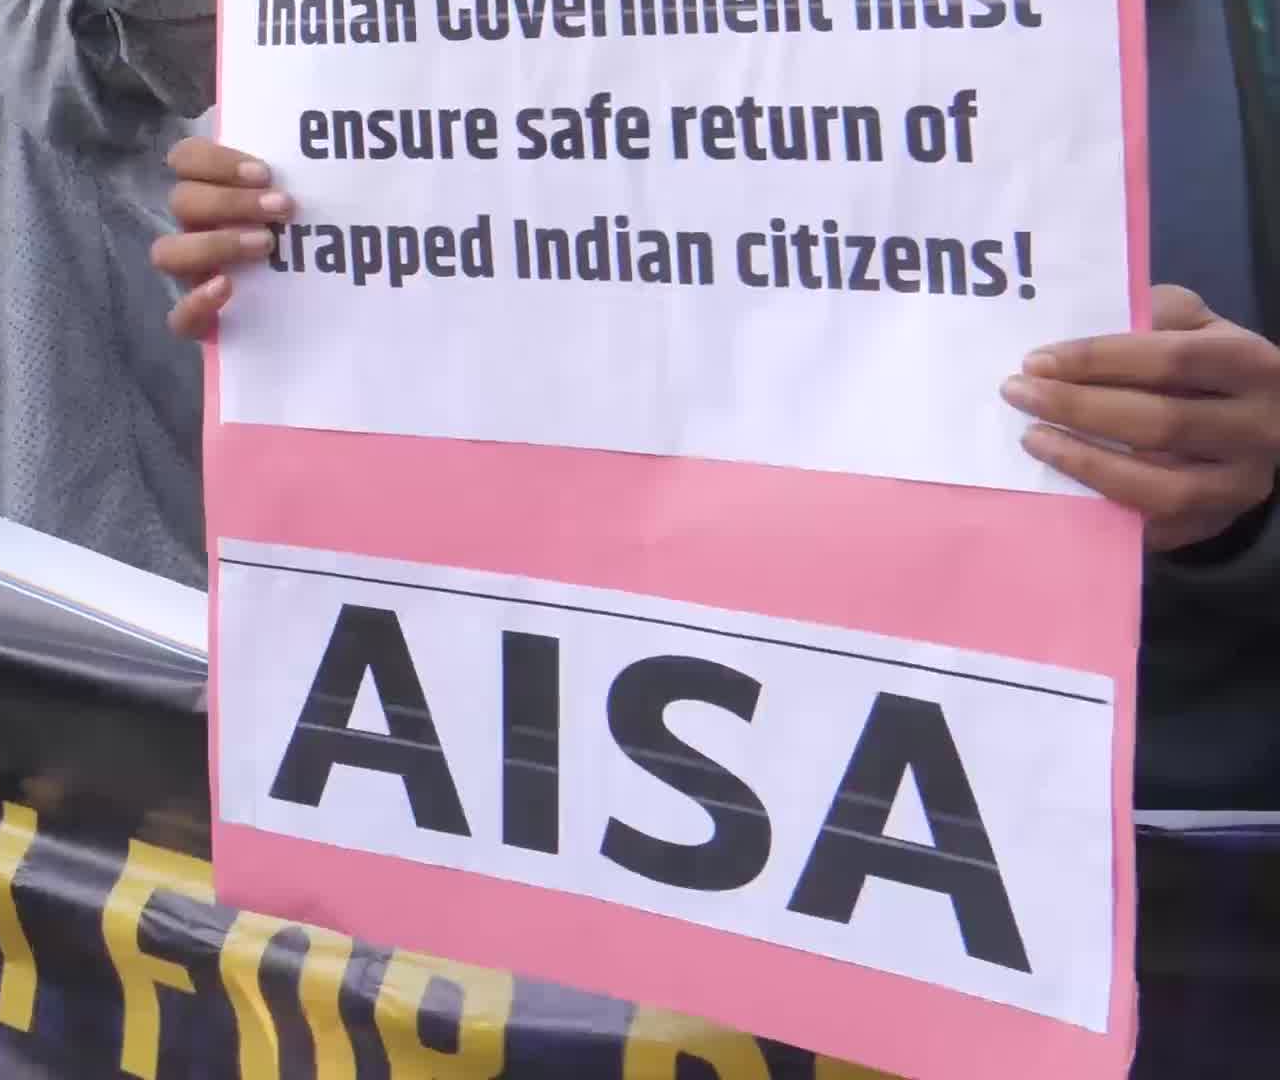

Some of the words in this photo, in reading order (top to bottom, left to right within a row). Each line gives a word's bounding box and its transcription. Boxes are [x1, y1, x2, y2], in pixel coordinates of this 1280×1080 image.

[299, 104, 499, 161] ensure
[517, 92, 653, 161] safe
[672, 97, 884, 163] return
[906, 88, 978, 164] of
[267, 215, 495, 289] trapped
[514, 215, 716, 287] Indian
[736, 218, 1038, 300] citizens!
[268, 602, 1034, 976] AISA
